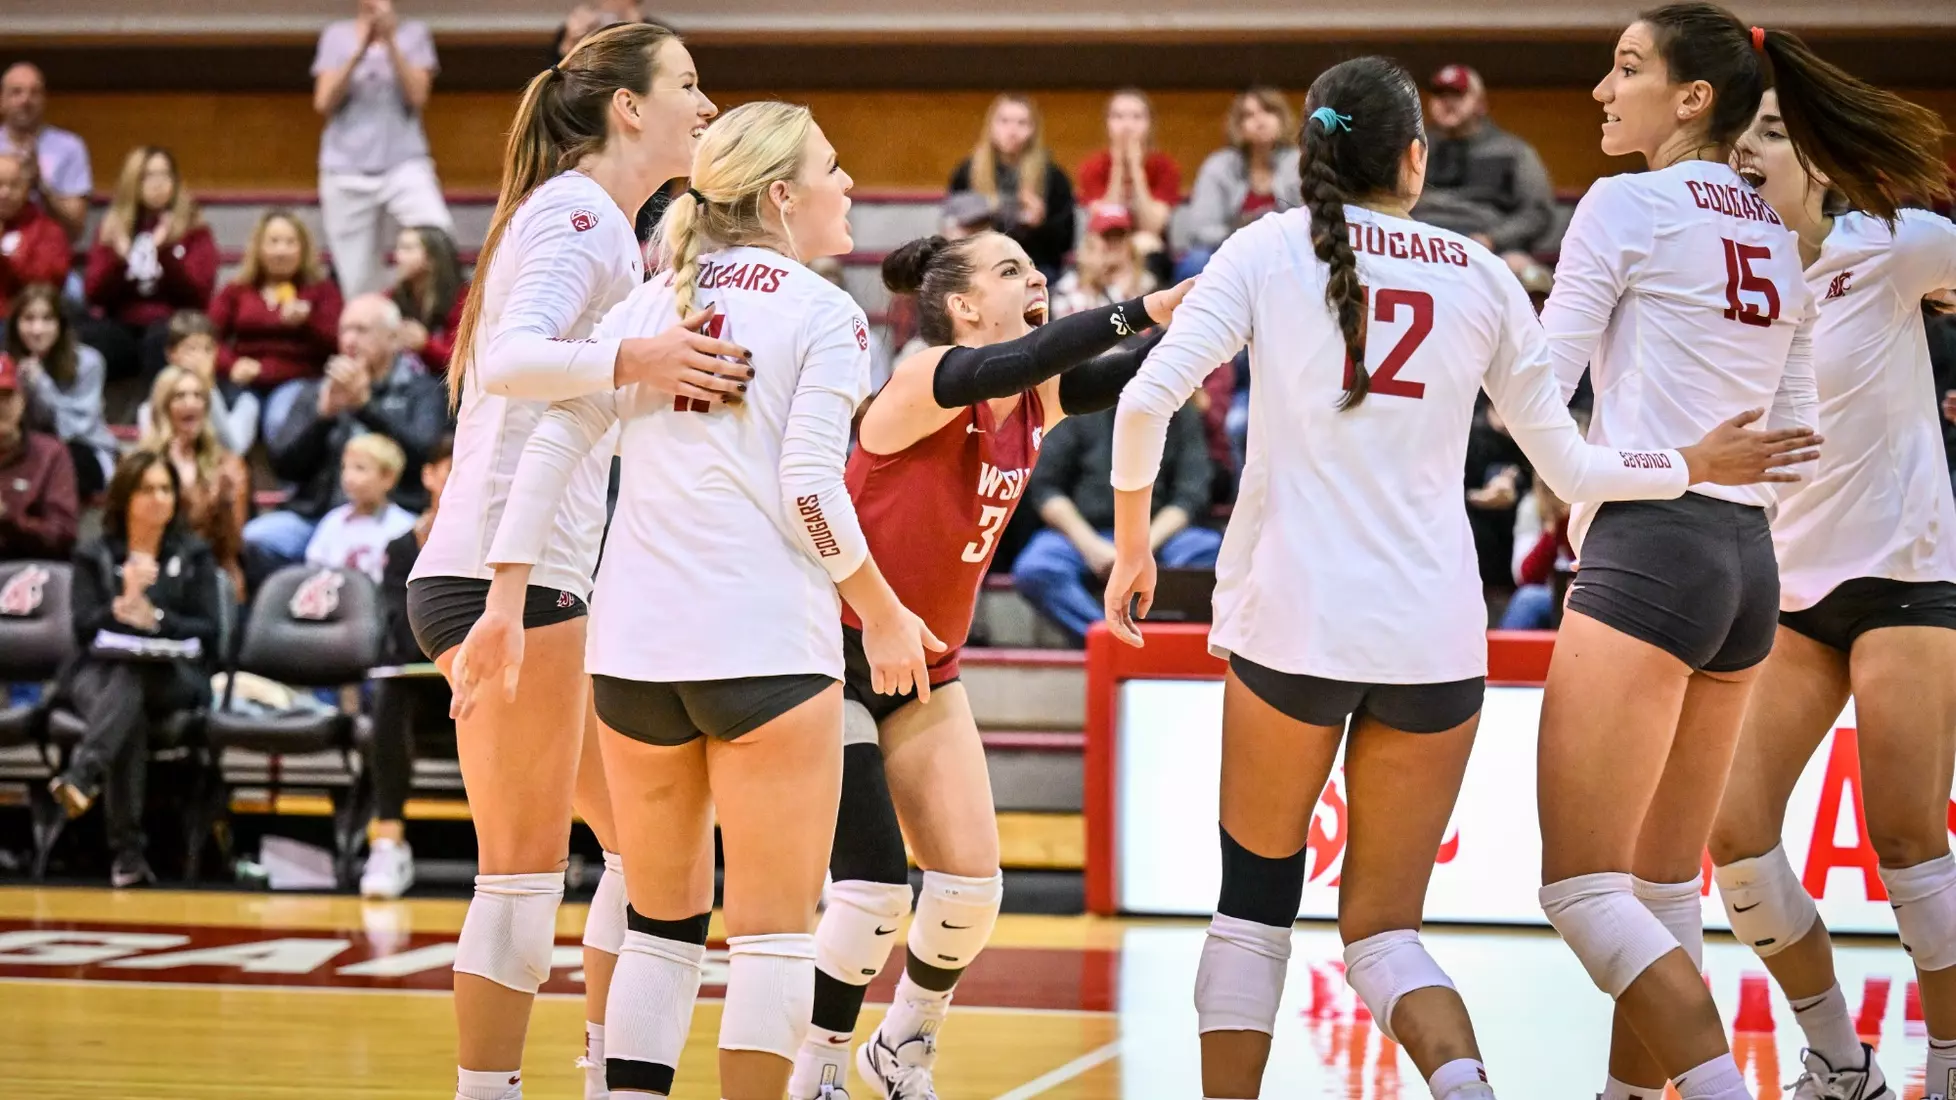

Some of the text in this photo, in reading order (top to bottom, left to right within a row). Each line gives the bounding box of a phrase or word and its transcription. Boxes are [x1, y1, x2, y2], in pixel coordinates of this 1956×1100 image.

[1685, 180, 1781, 226] COUGARS
[1720, 236, 1781, 328] 15
[797, 494, 841, 558] COUGARS
[961, 504, 1008, 563] 3
